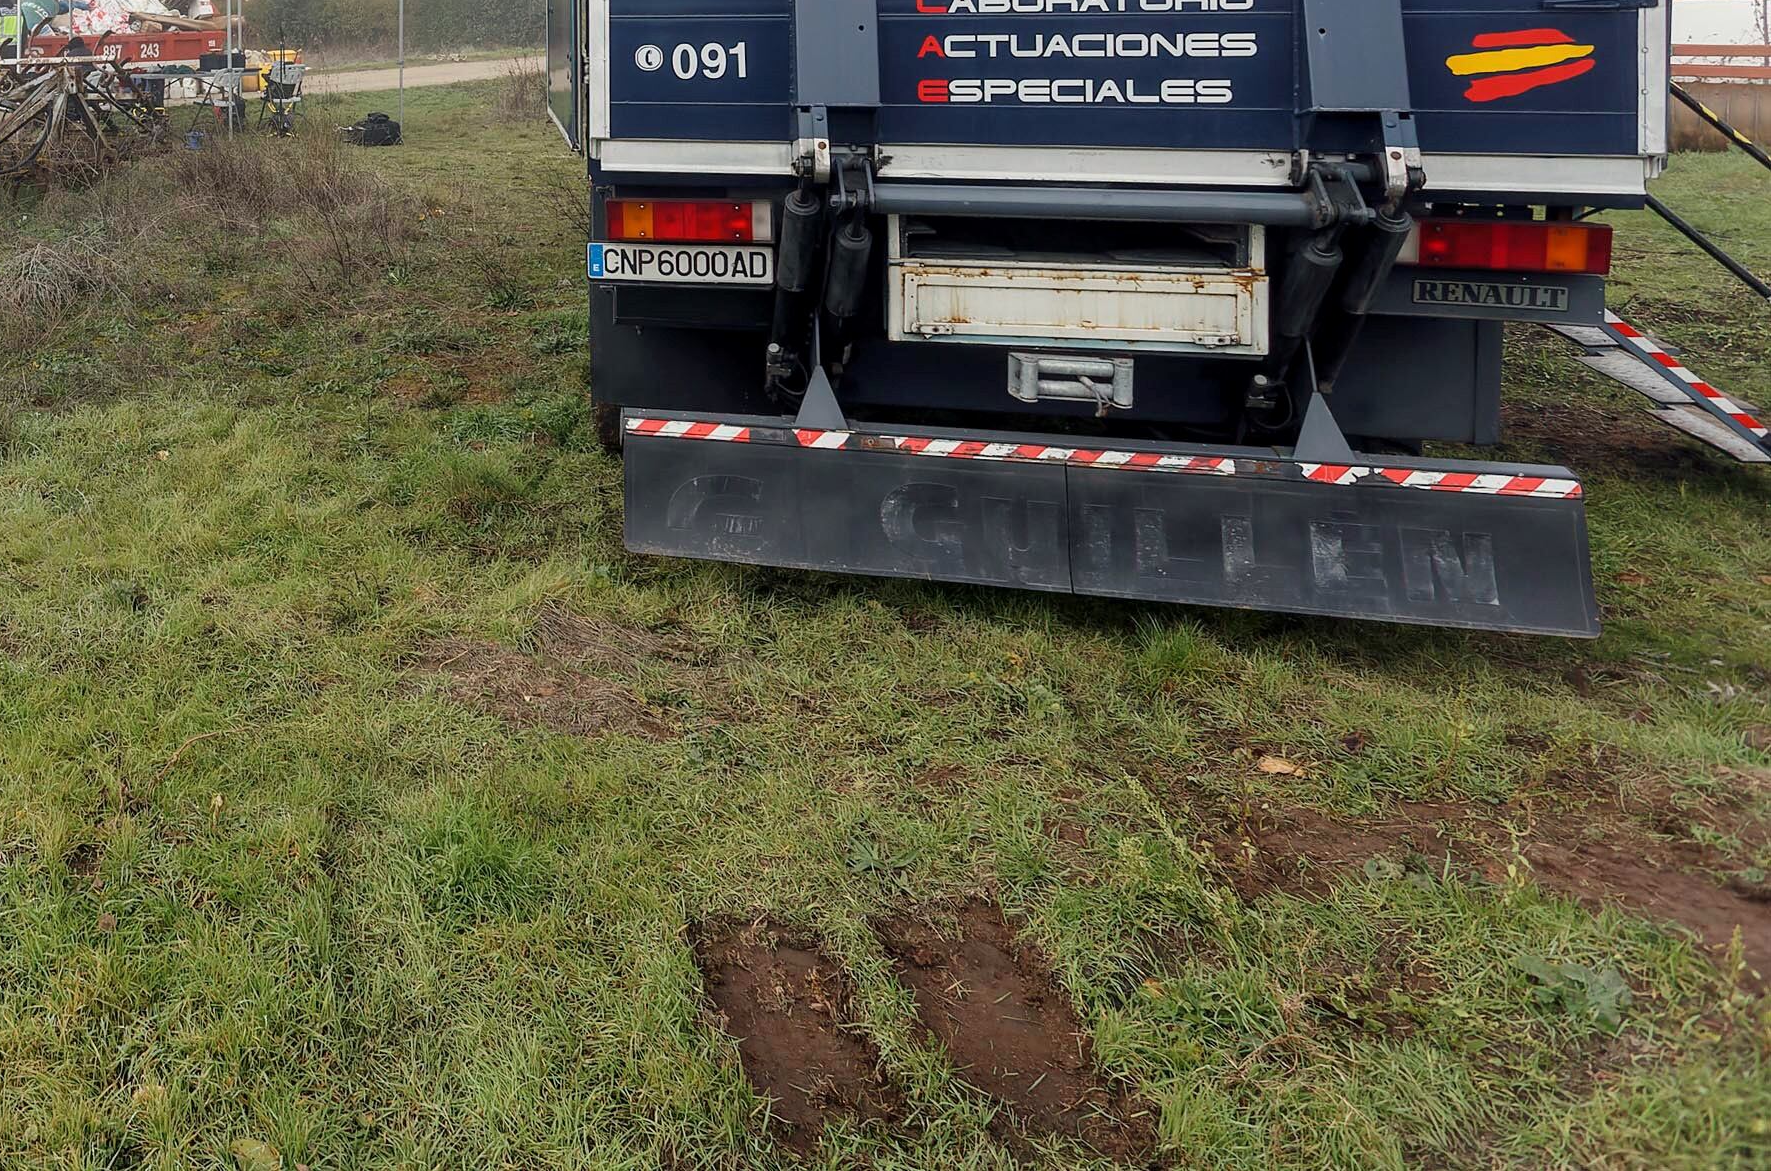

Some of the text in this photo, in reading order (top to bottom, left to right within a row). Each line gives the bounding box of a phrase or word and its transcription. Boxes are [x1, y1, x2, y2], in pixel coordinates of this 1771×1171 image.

[140, 43, 160, 58] 243
[916, 33, 1258, 58] ACTUACIONES
[672, 42, 747, 79] 091
[916, 79, 1234, 104] ESPECIALES
[592, 263, 600, 272] E
[1415, 281, 1565, 308] RENAULT
[666, 474, 765, 538] G
